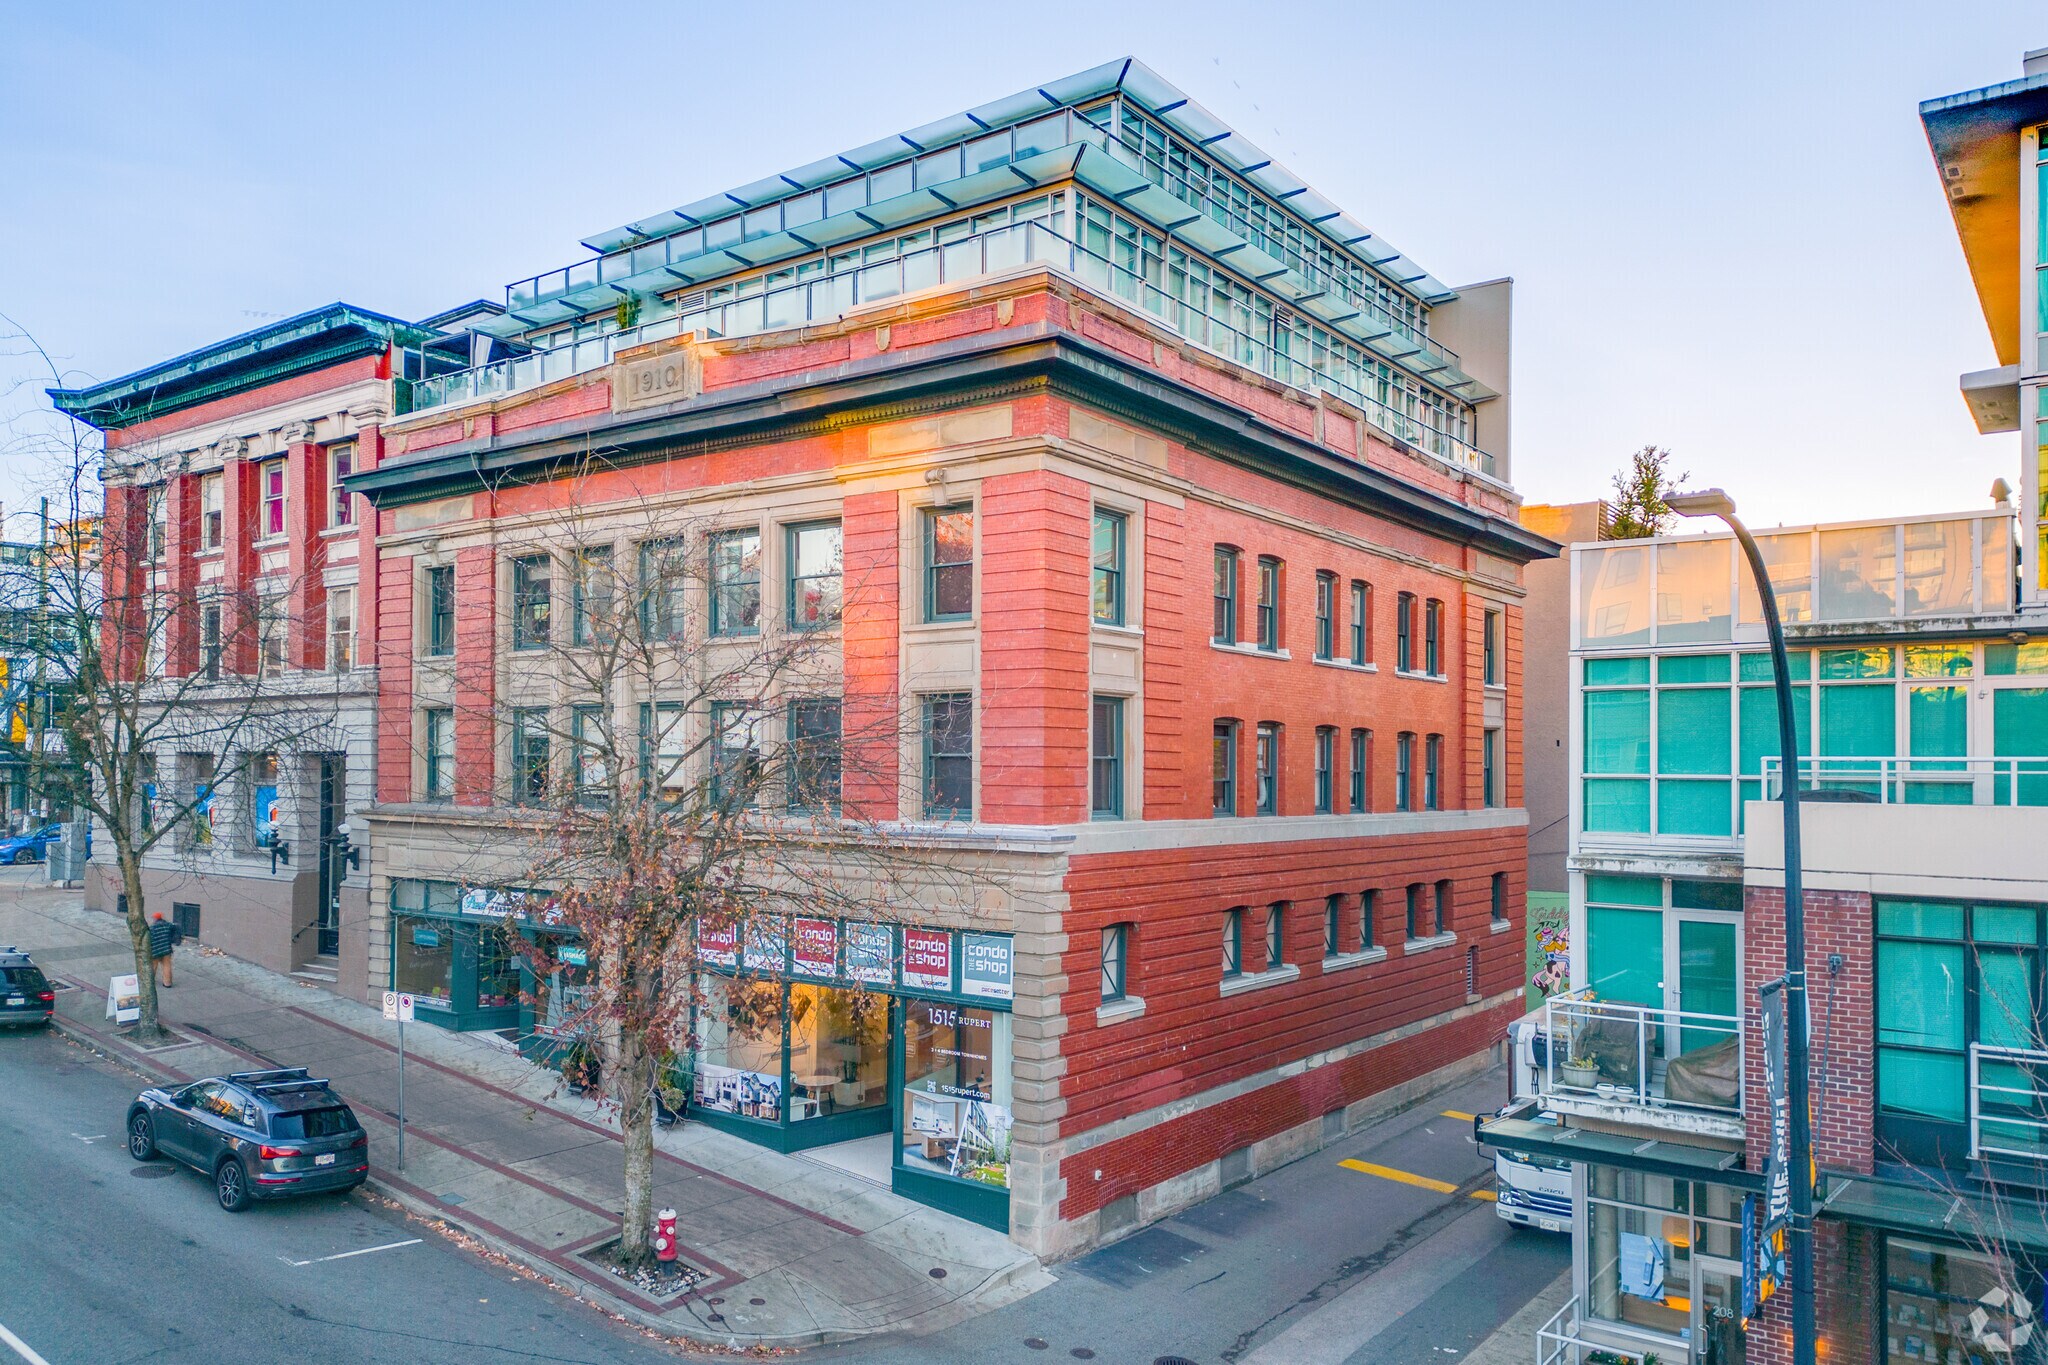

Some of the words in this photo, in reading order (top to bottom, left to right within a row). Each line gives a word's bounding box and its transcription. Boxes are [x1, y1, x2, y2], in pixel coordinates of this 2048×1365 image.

[908, 939, 946, 953] condo
[968, 944, 1008, 960] condo
[916, 952, 946, 969] shop
[975, 958, 1008, 976] shop
[928, 1008, 957, 1027] 1515
[958, 1017, 992, 1029] RUPERT
[941, 1085, 991, 1099] 1515rupert.com
[1713, 1306, 1734, 1319] 208
